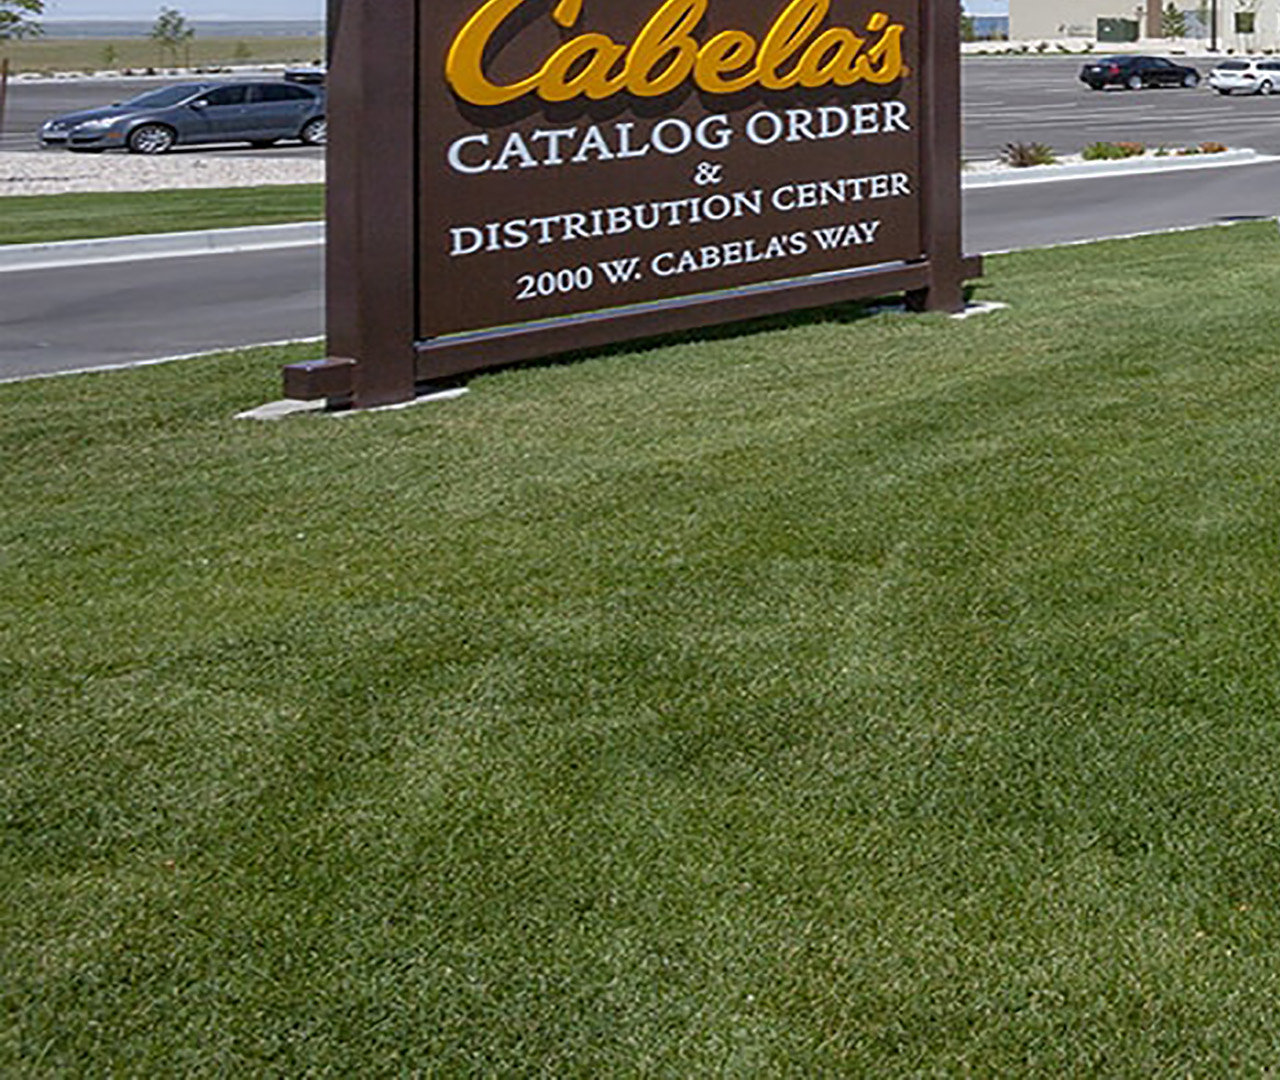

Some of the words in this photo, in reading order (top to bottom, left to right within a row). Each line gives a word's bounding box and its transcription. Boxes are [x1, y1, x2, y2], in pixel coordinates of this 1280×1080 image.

[447, 114, 733, 174] CATALOG
[746, 100, 911, 145] ORDER
[694, 161, 722, 186] &
[450, 189, 763, 256] DISTRIBUTION
[771, 172, 911, 211] CENTER
[516, 266, 593, 300] 2000
[597, 256, 642, 284] W.
[651, 231, 808, 276] CABELA'S
[812, 220, 882, 250] WAY
